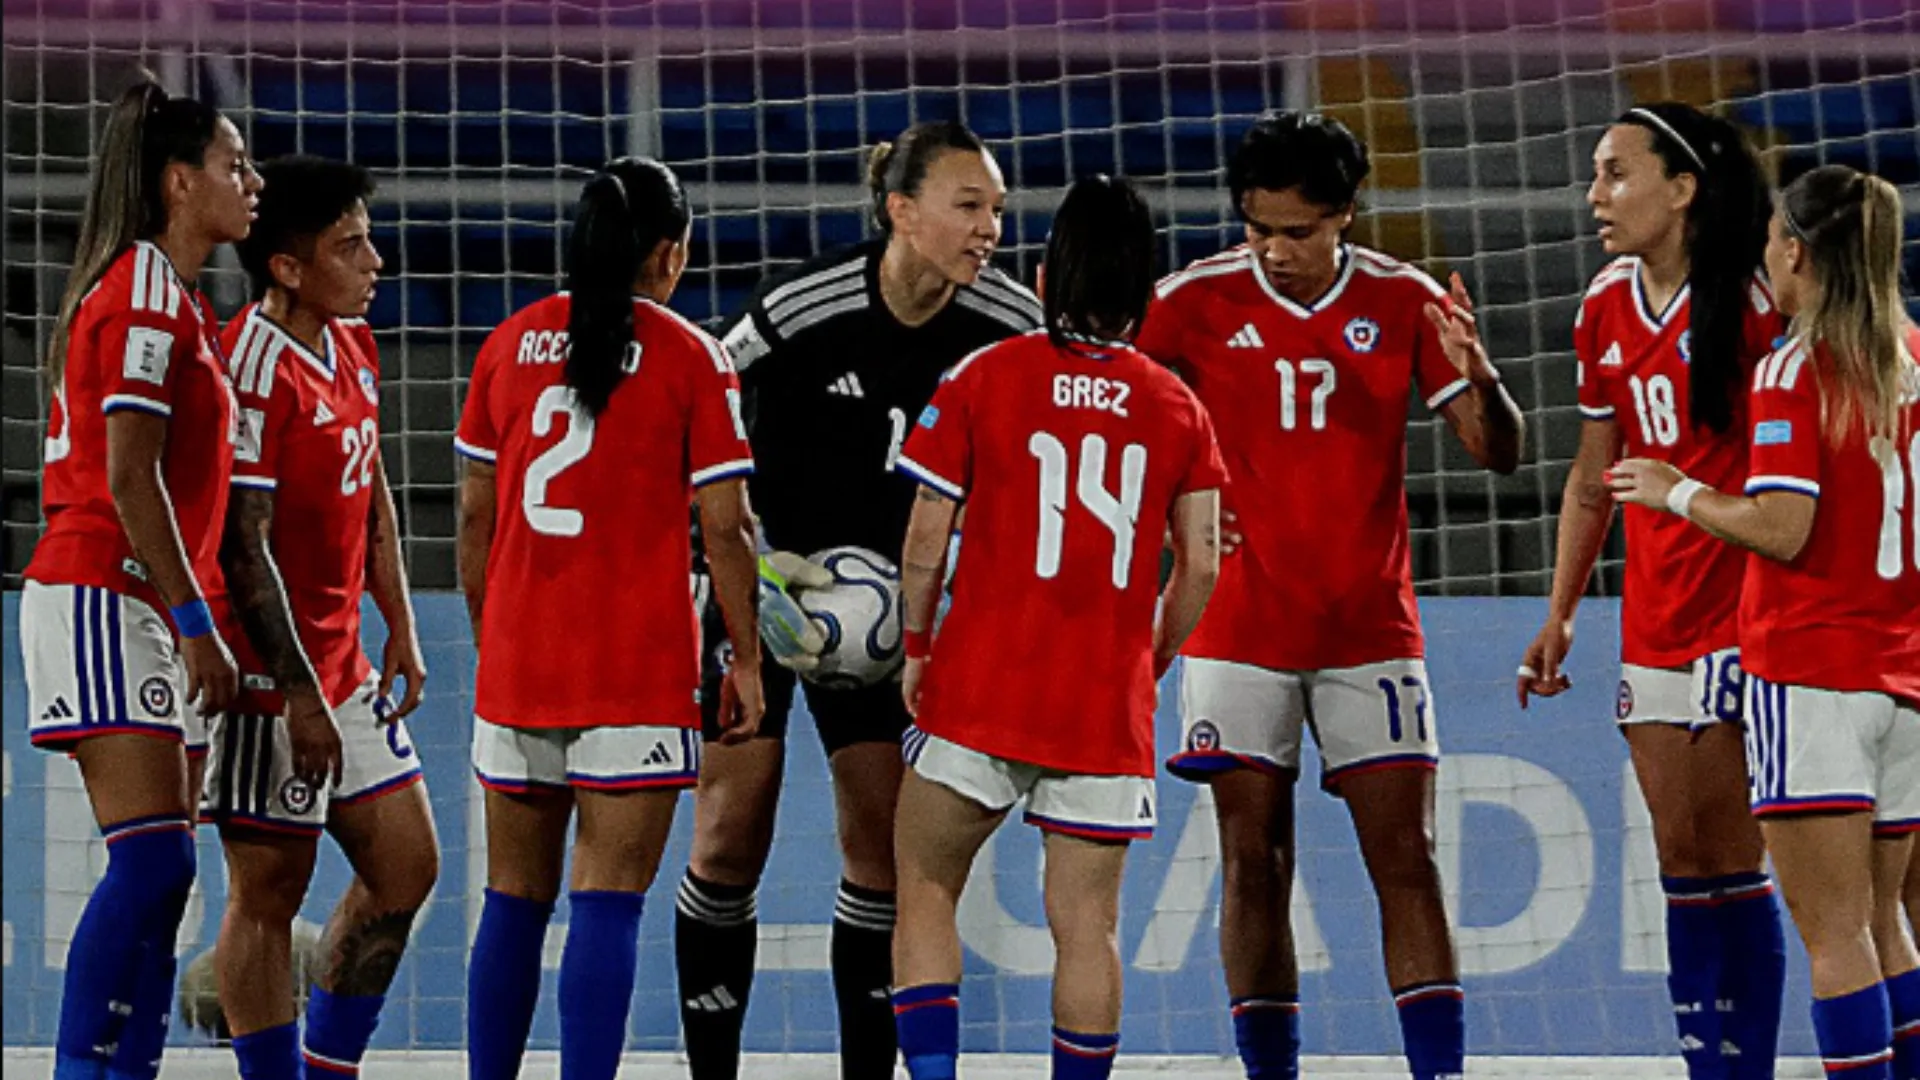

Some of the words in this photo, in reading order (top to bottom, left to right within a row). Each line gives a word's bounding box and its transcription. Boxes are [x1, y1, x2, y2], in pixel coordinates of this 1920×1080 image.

[517, 329, 643, 374] ACEO
[1052, 374, 1131, 418] GREZ
[1274, 357, 1336, 430] 17
[1628, 374, 1679, 447] 18
[340, 416, 378, 496] 22
[521, 385, 595, 537] 2
[1028, 430, 1148, 590] 14
[1869, 431, 1920, 580] 1
